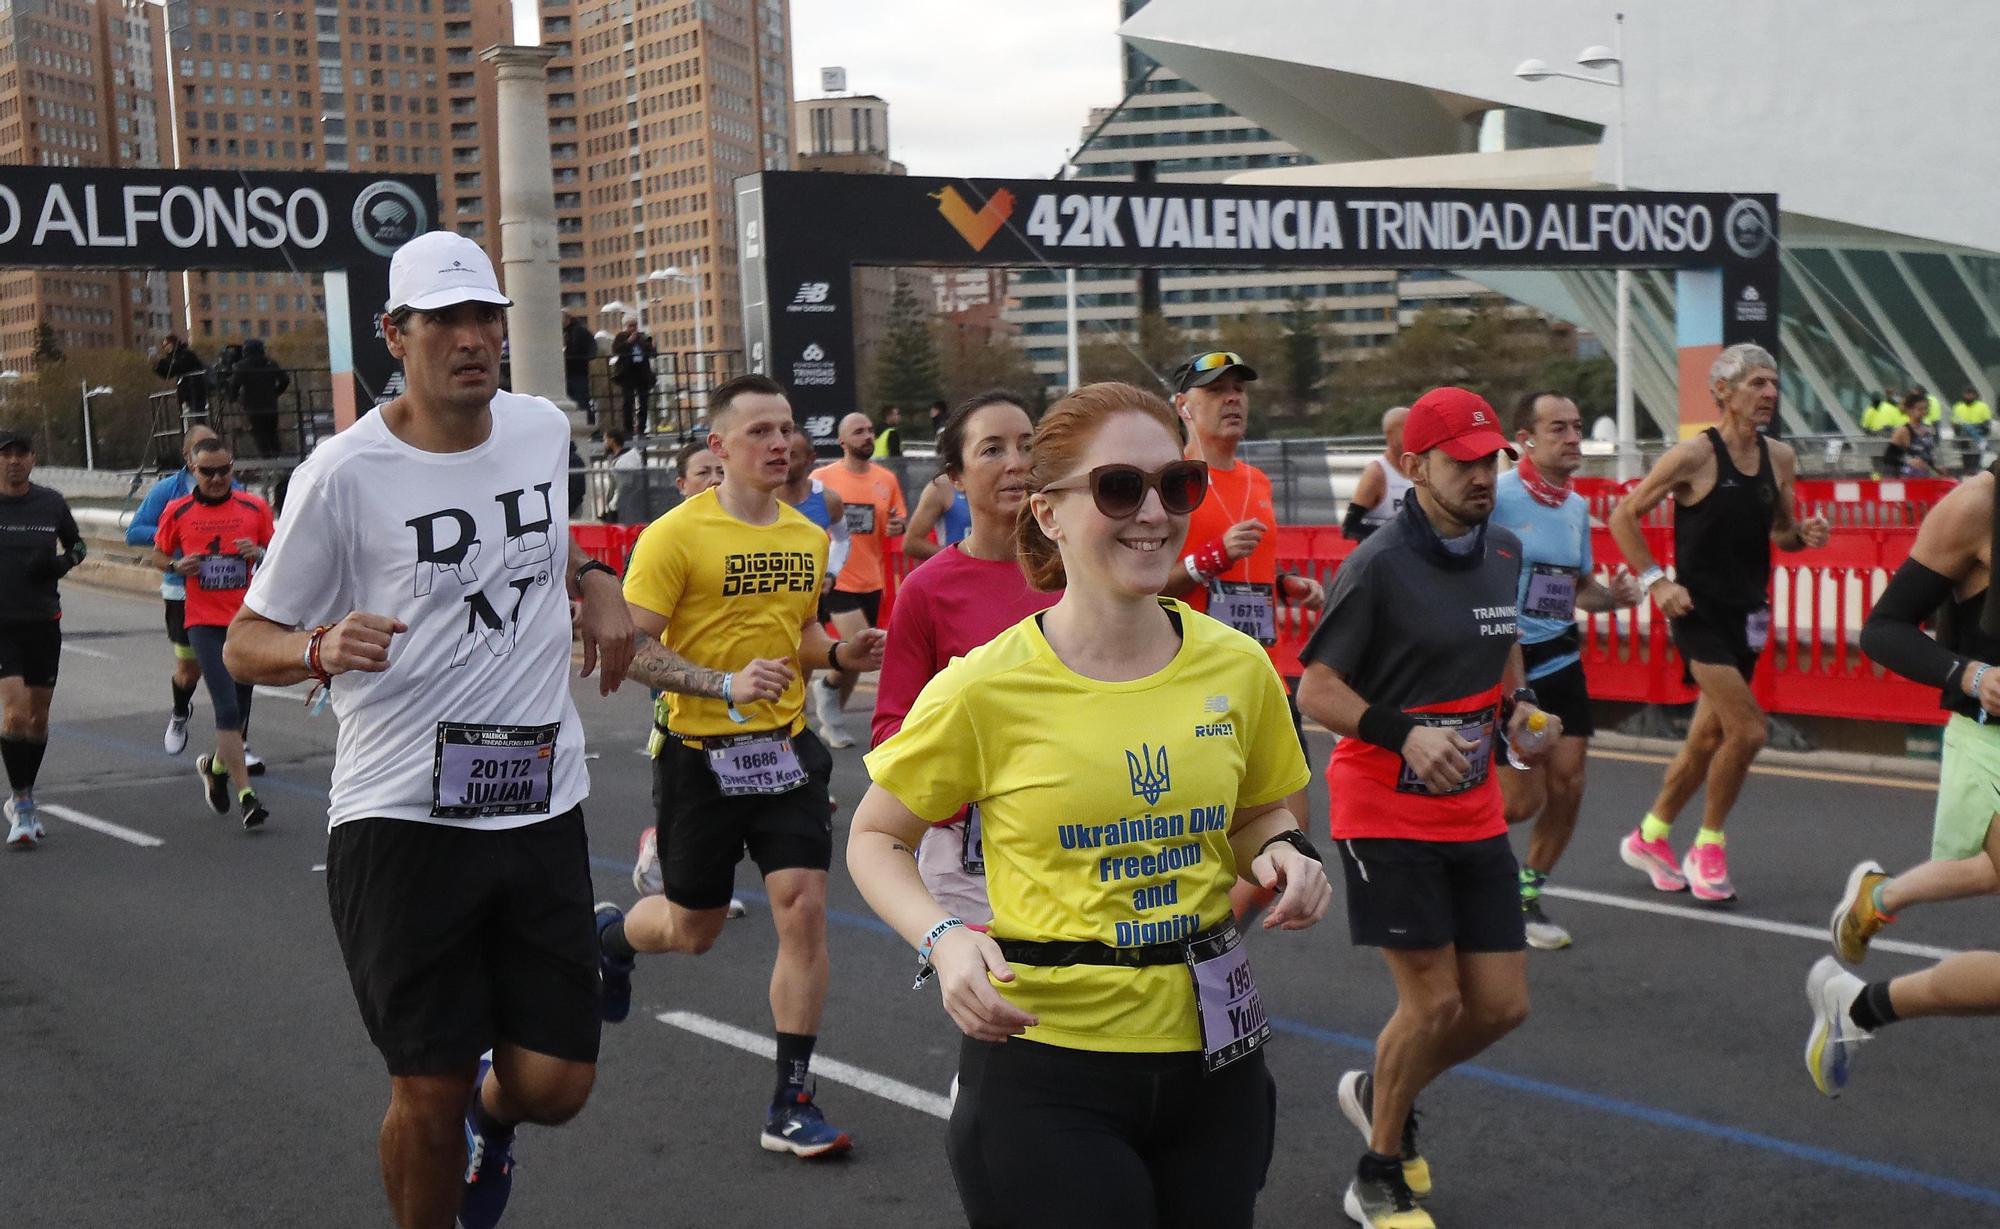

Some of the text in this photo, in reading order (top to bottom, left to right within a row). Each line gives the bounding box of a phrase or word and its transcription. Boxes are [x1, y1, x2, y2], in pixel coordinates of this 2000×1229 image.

[33, 184, 328, 248] ALFONSO
[1026, 195, 1713, 252] 42K VALENCIA TRINIDAD ALFONSO
[722, 571, 815, 597] DEEPER
[1473, 606, 1517, 620] TRAINING
[1480, 623, 1516, 637] PLANET
[482, 732, 508, 740] VALENCIA
[1195, 723, 1233, 738] RUN21
[470, 758, 531, 780] 20172
[732, 751, 778, 771] 18686
[775, 768, 802, 784] Ken
[459, 780, 533, 805] JULIAN
[1058, 804, 1227, 850] Ukrainian DNA
[1100, 842, 1201, 882] Freedom
[1133, 879, 1178, 911] and
[931, 923, 947, 939] 42K
[1114, 914, 1200, 946] Dignity
[1227, 993, 1265, 1039] Yuli
